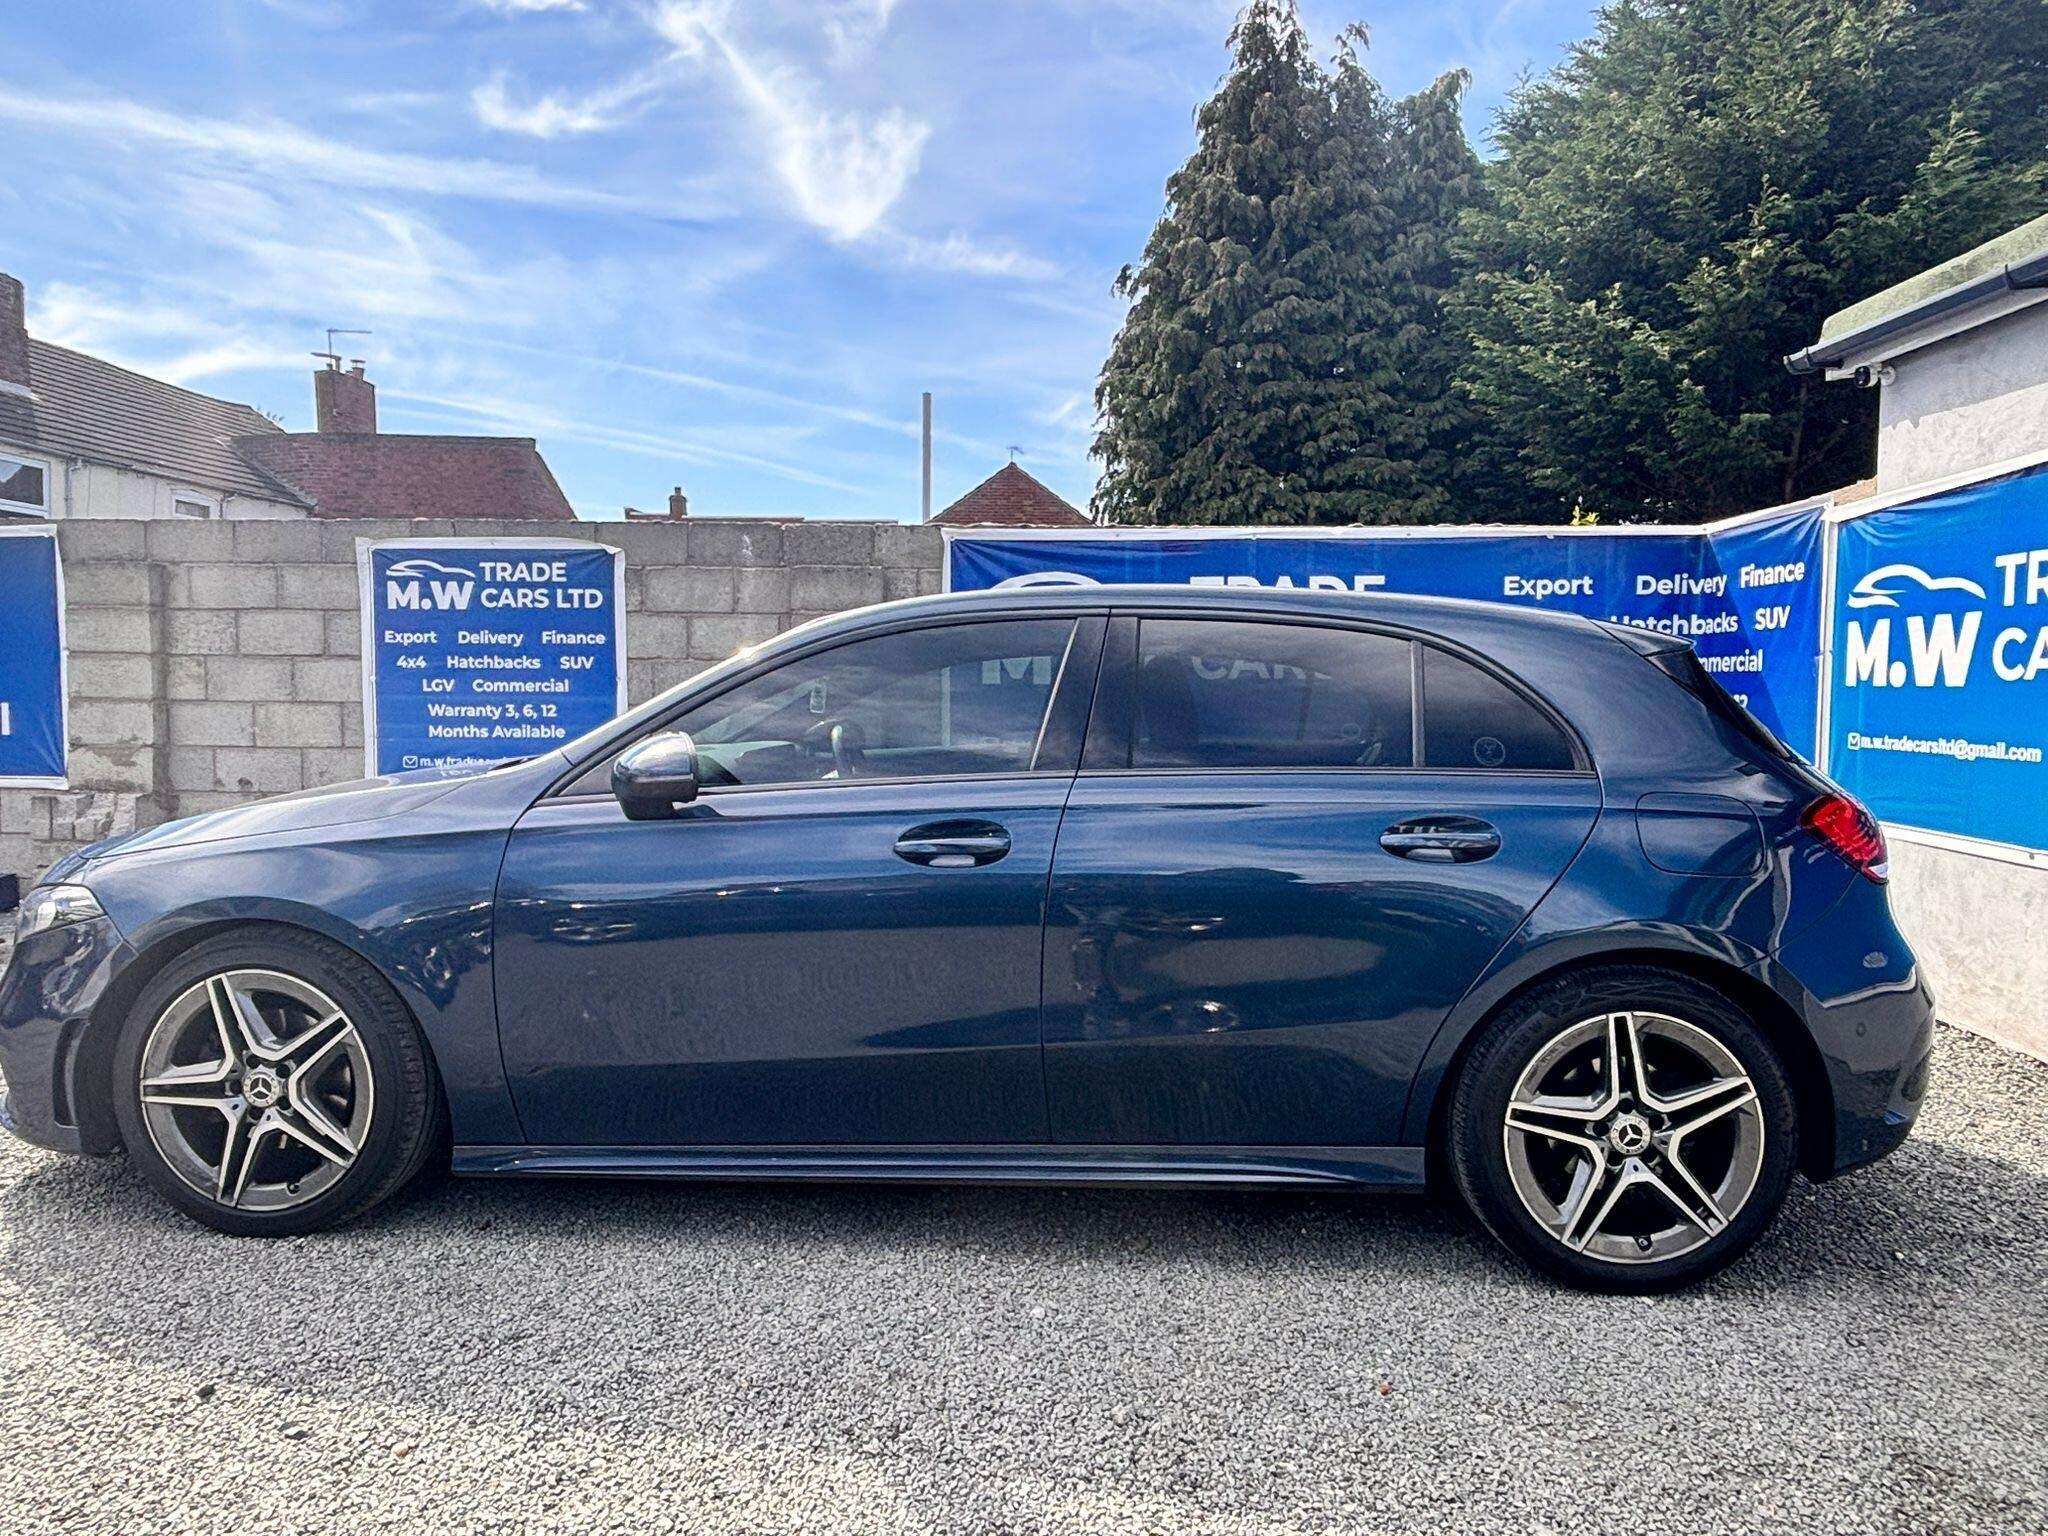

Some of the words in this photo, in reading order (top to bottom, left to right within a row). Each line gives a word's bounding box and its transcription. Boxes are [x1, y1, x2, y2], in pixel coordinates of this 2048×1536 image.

[479, 562, 567, 582] TRADE
[1503, 575, 1594, 600] Export
[1636, 573, 1728, 597] Delivery
[1740, 561, 1805, 588] Finance
[386, 581, 475, 610] M.W
[480, 588, 550, 609] CARS
[556, 588, 603, 609] LTD
[1754, 605, 1791, 631] SUV
[384, 630, 437, 647] Export
[458, 630, 524, 647] Delivery
[542, 630, 606, 645] Finance
[1845, 610, 1983, 688] M.W
[397, 655, 427, 669] 4x4
[447, 655, 541, 669] Hatchbacks
[560, 656, 594, 669] SUV
[422, 678, 455, 692] LGV
[472, 678, 569, 693] Commercial
[428, 703, 502, 720] Warranty
[505, 703, 520, 720] 3,
[522, 703, 538, 719] 6,
[541, 703, 558, 718] 12
[428, 724, 489, 738] Months
[492, 724, 566, 739] Available
[1860, 735, 2042, 763] m.w.tradecarsltd@gmail.com
